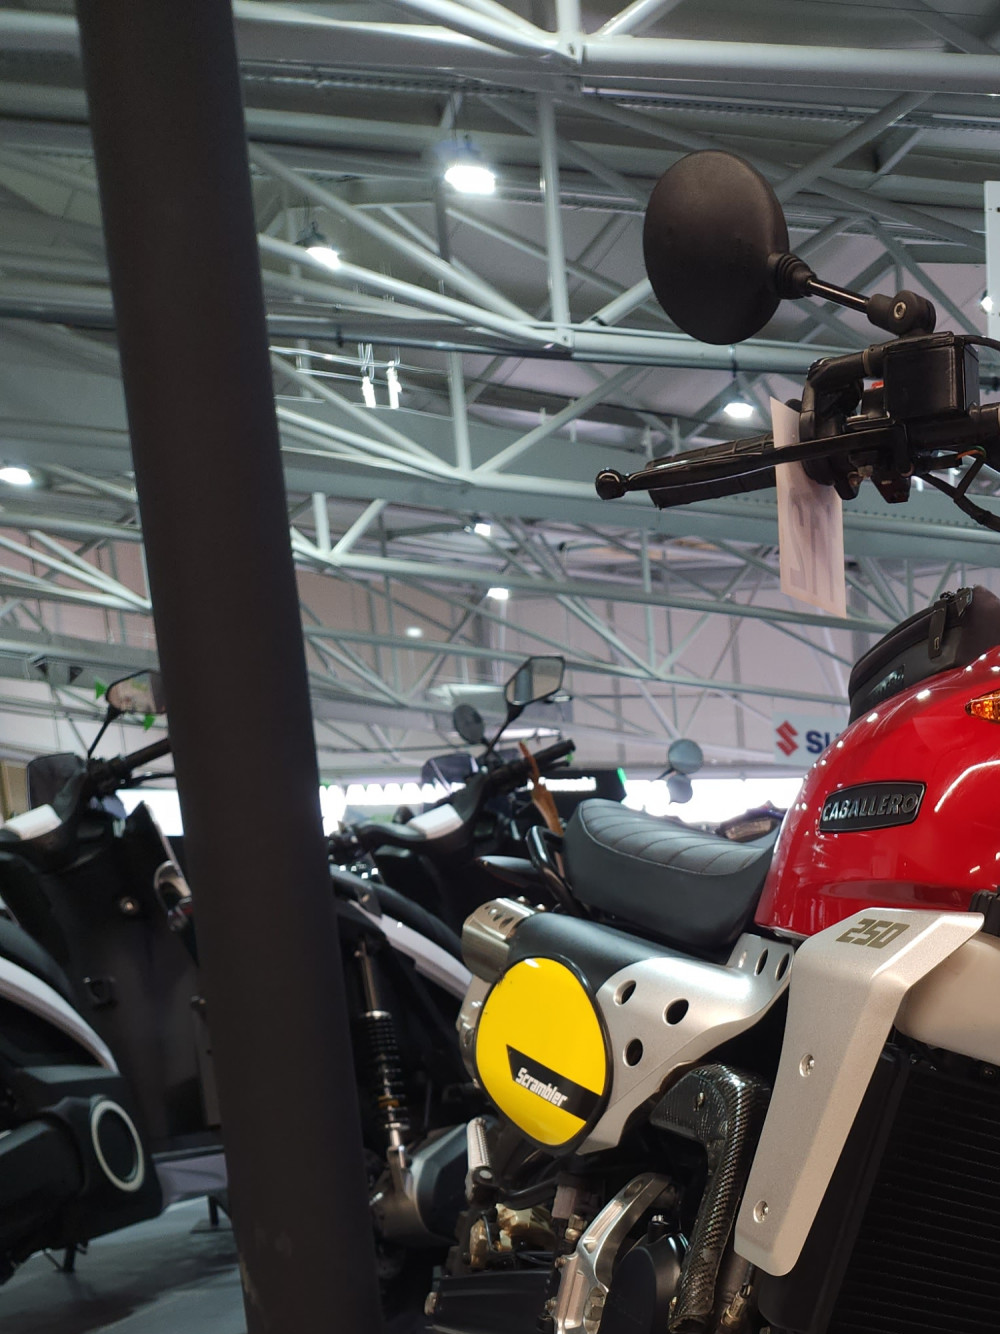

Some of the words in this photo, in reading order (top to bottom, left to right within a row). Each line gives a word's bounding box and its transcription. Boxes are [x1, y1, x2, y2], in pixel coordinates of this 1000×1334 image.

[822, 793, 919, 822] CABALLERO
[835, 918, 911, 950] 250
[515, 1067, 569, 1107] Scrambler
